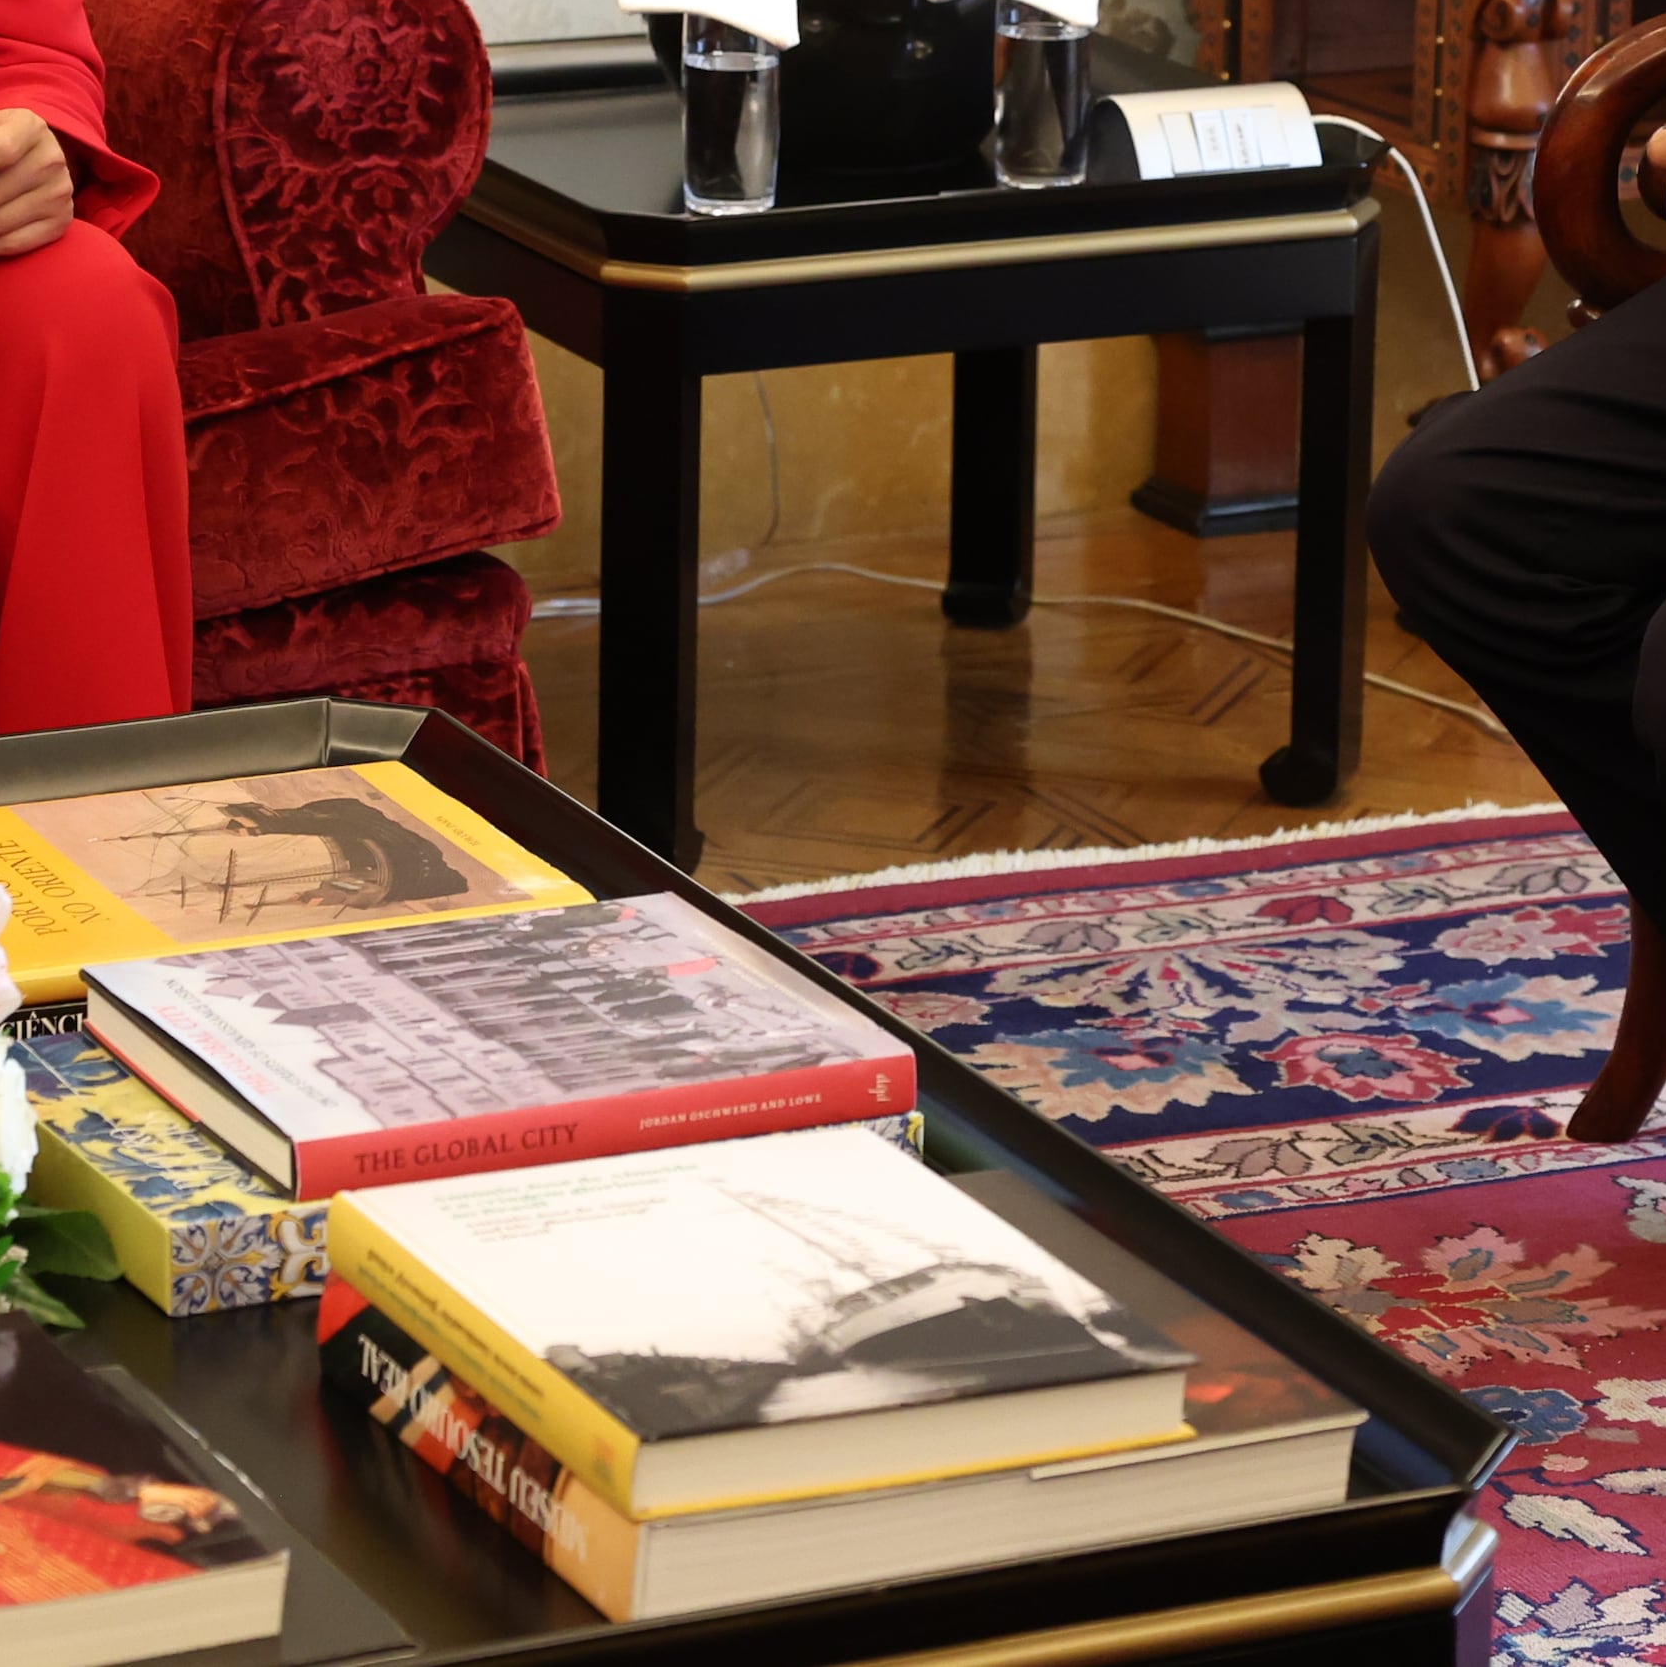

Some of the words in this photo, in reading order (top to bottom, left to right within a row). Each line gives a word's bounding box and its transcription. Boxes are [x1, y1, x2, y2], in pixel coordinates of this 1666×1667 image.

[354, 1148, 406, 1174] THE
[413, 1132, 514, 1167] GLOBAL
[521, 1123, 579, 1150] CITY
[639, 1112, 687, 1131] JORDAN
[760, 1097, 787, 1112] AND
[789, 1093, 823, 1107] LOWE
[358, 1333, 411, 1409] REAL
[409, 1384, 507, 1496] TESOURO
[508, 1465, 588, 1565] MUSEU
